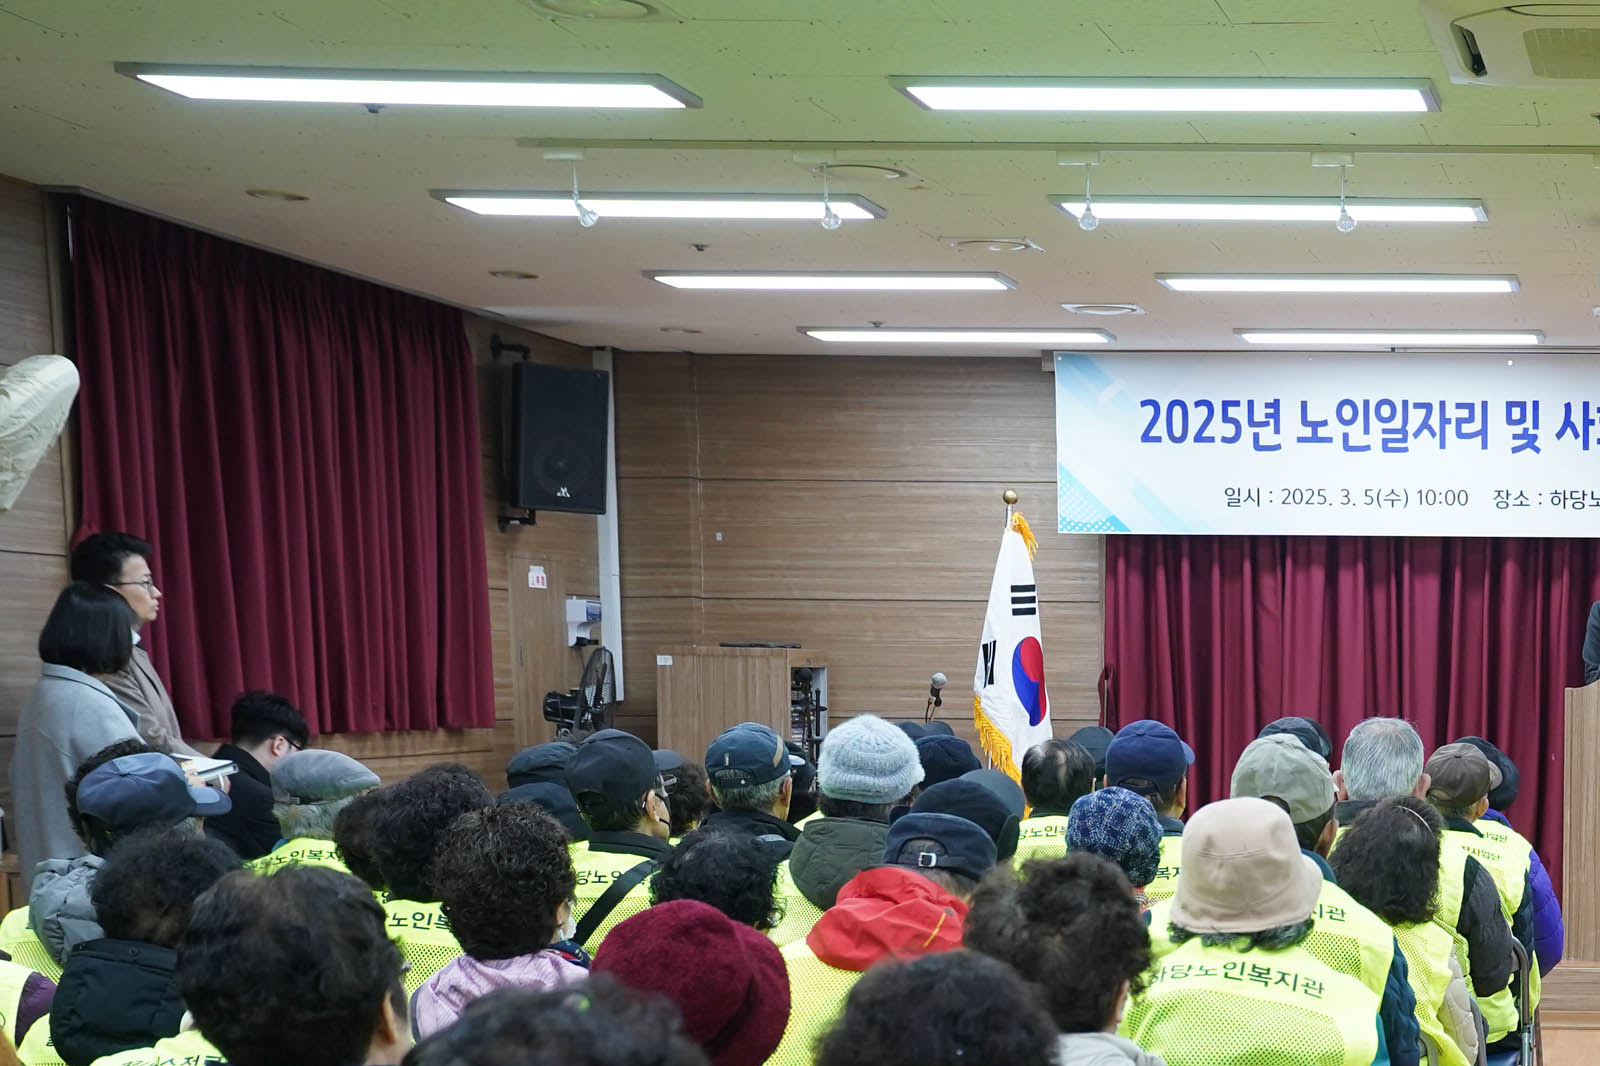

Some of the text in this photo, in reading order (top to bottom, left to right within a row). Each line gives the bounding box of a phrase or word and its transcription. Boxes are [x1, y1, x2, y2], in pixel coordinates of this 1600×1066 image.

[1139, 398, 1282, 452] 2025년
[1296, 397, 1489, 454] 노인일자리
[1505, 398, 1542, 455] 및
[1224, 487, 1261, 508] 일시
[1280, 487, 1333, 507] 2025.
[1340, 488, 1357, 507] 3.
[1363, 488, 1409, 509] 5(수)
[1416, 488, 1469, 507] 10:00
[1493, 489, 1531, 510] 장소
